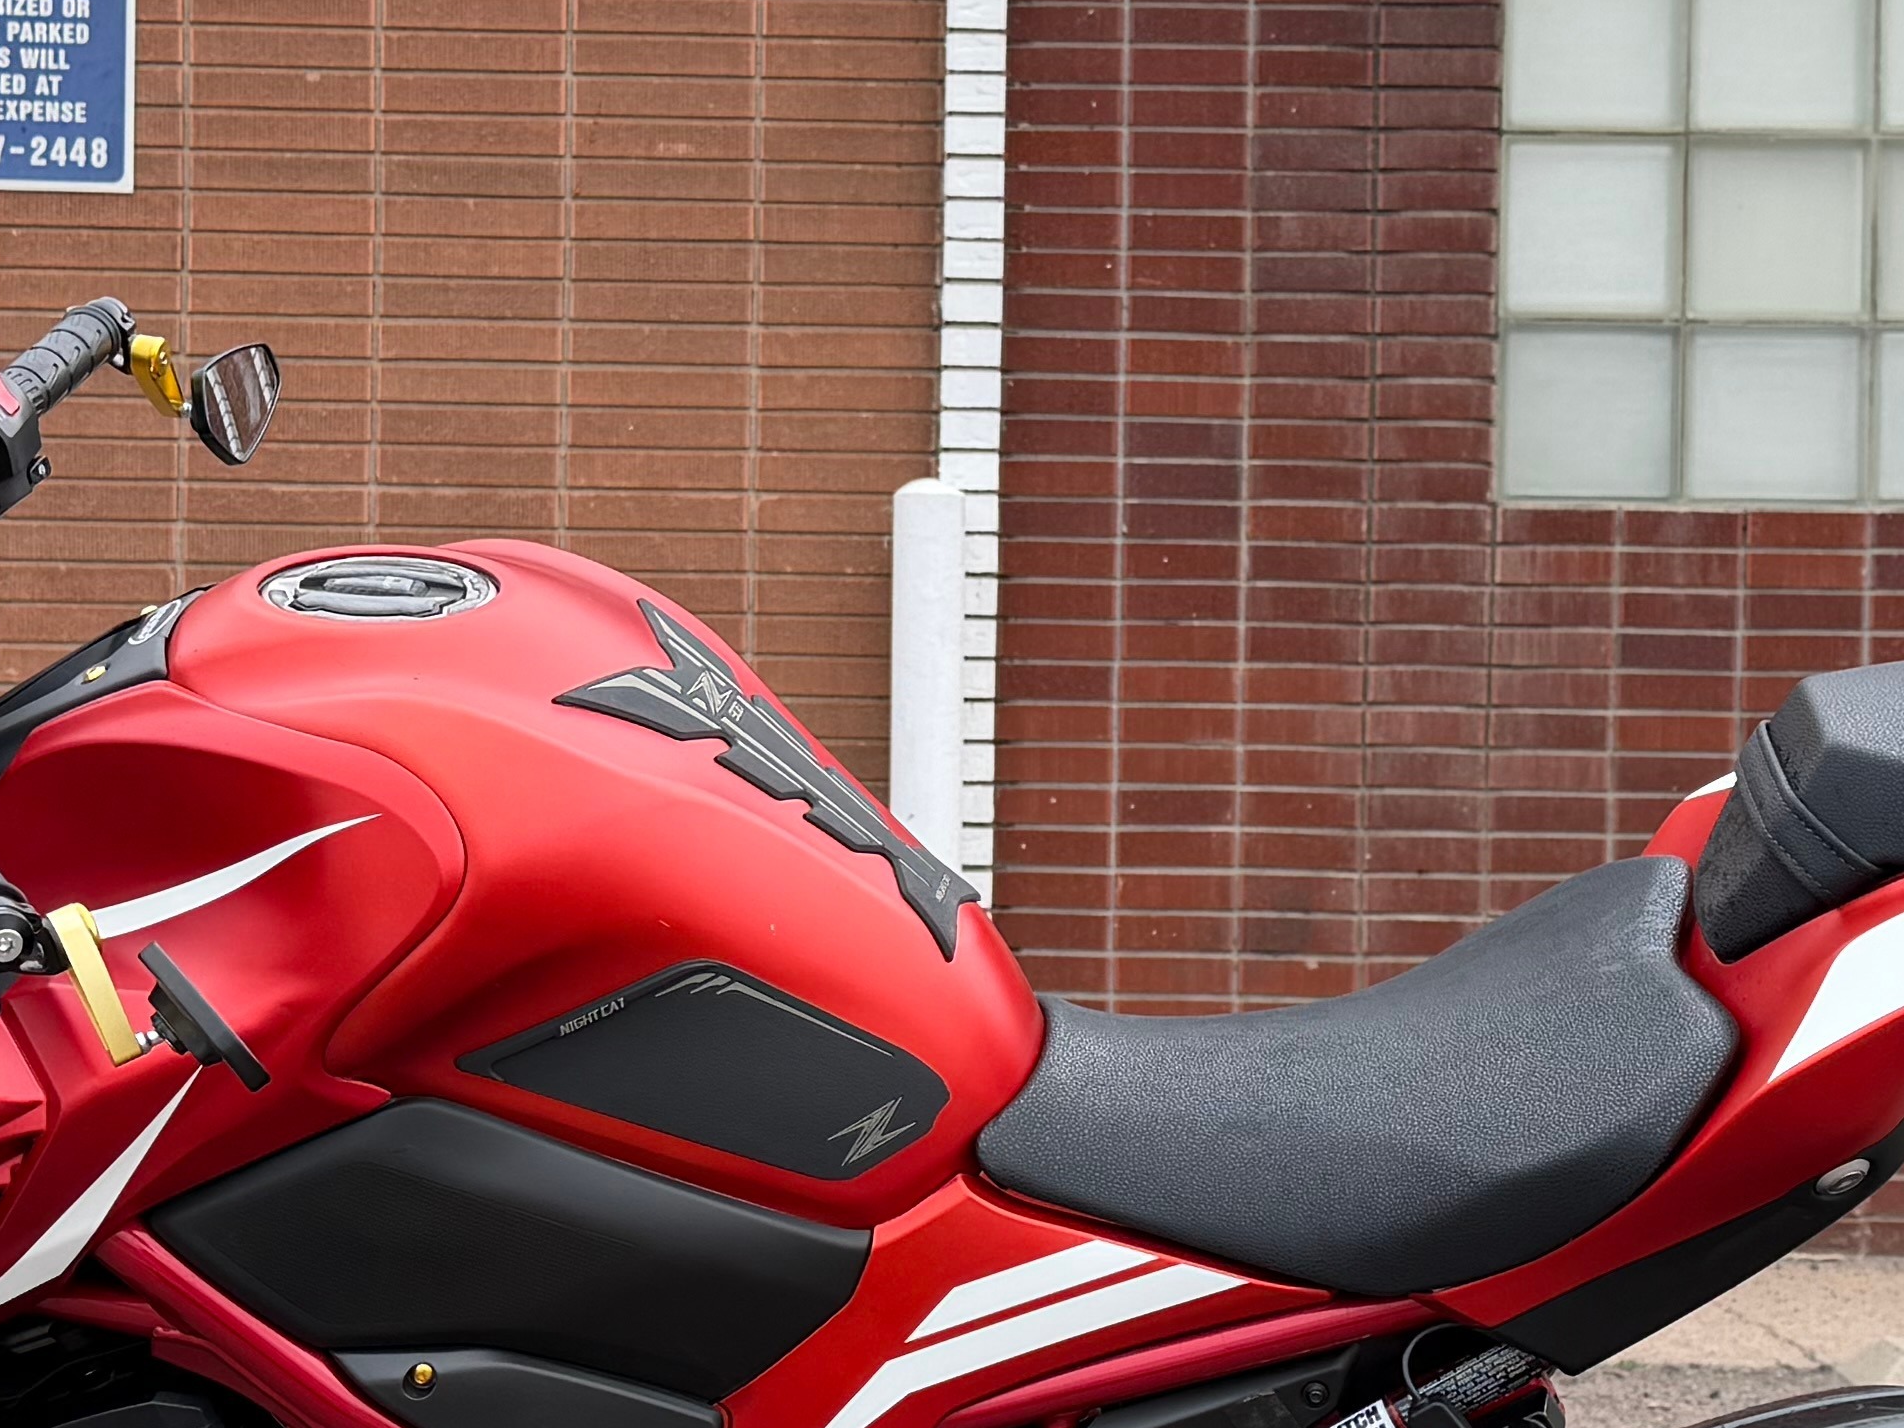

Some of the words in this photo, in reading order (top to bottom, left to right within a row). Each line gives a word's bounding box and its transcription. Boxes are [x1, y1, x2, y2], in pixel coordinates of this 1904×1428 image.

[7, 22, 90, 44] PARKED
[20, 48, 70, 70] WILL
[35, 75, 63, 96] AT
